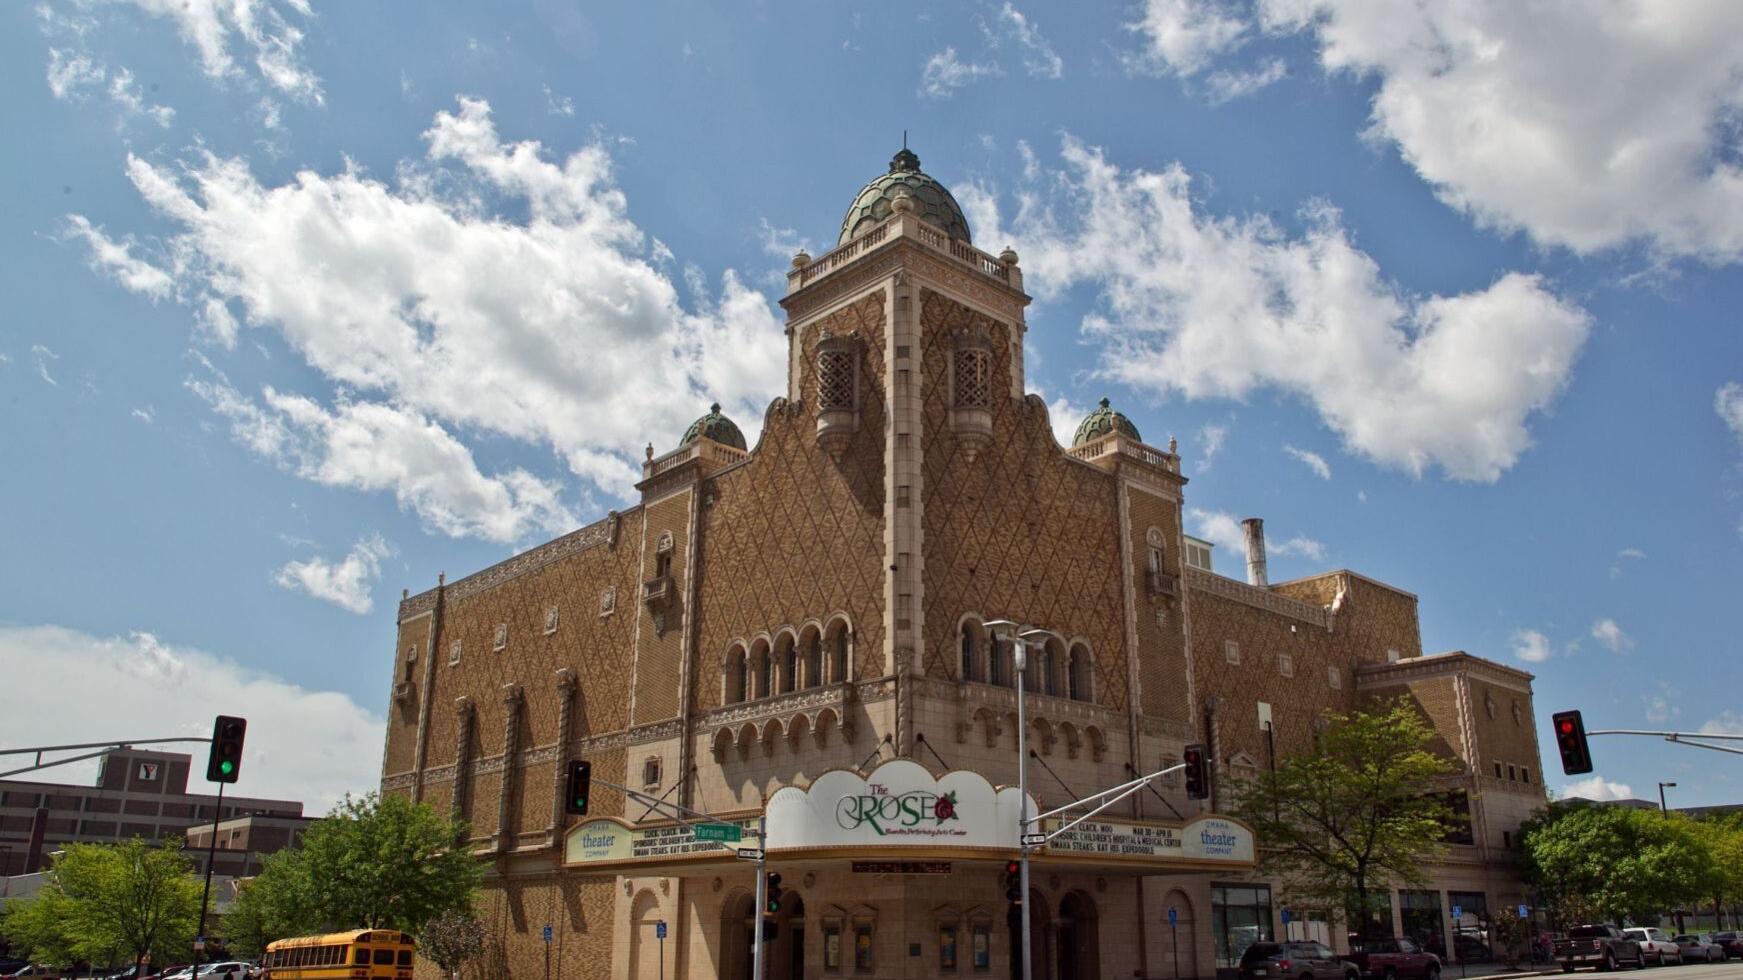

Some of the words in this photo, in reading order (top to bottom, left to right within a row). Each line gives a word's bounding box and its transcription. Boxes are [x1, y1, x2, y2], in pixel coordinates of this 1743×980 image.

[869, 784, 889, 796] The
[836, 790, 938, 836] ROSE
[697, 826, 725, 838] Farnam
[1200, 829, 1236, 847] theater
[582, 833, 616, 849] theater
[1206, 847, 1232, 855] COMPANY
